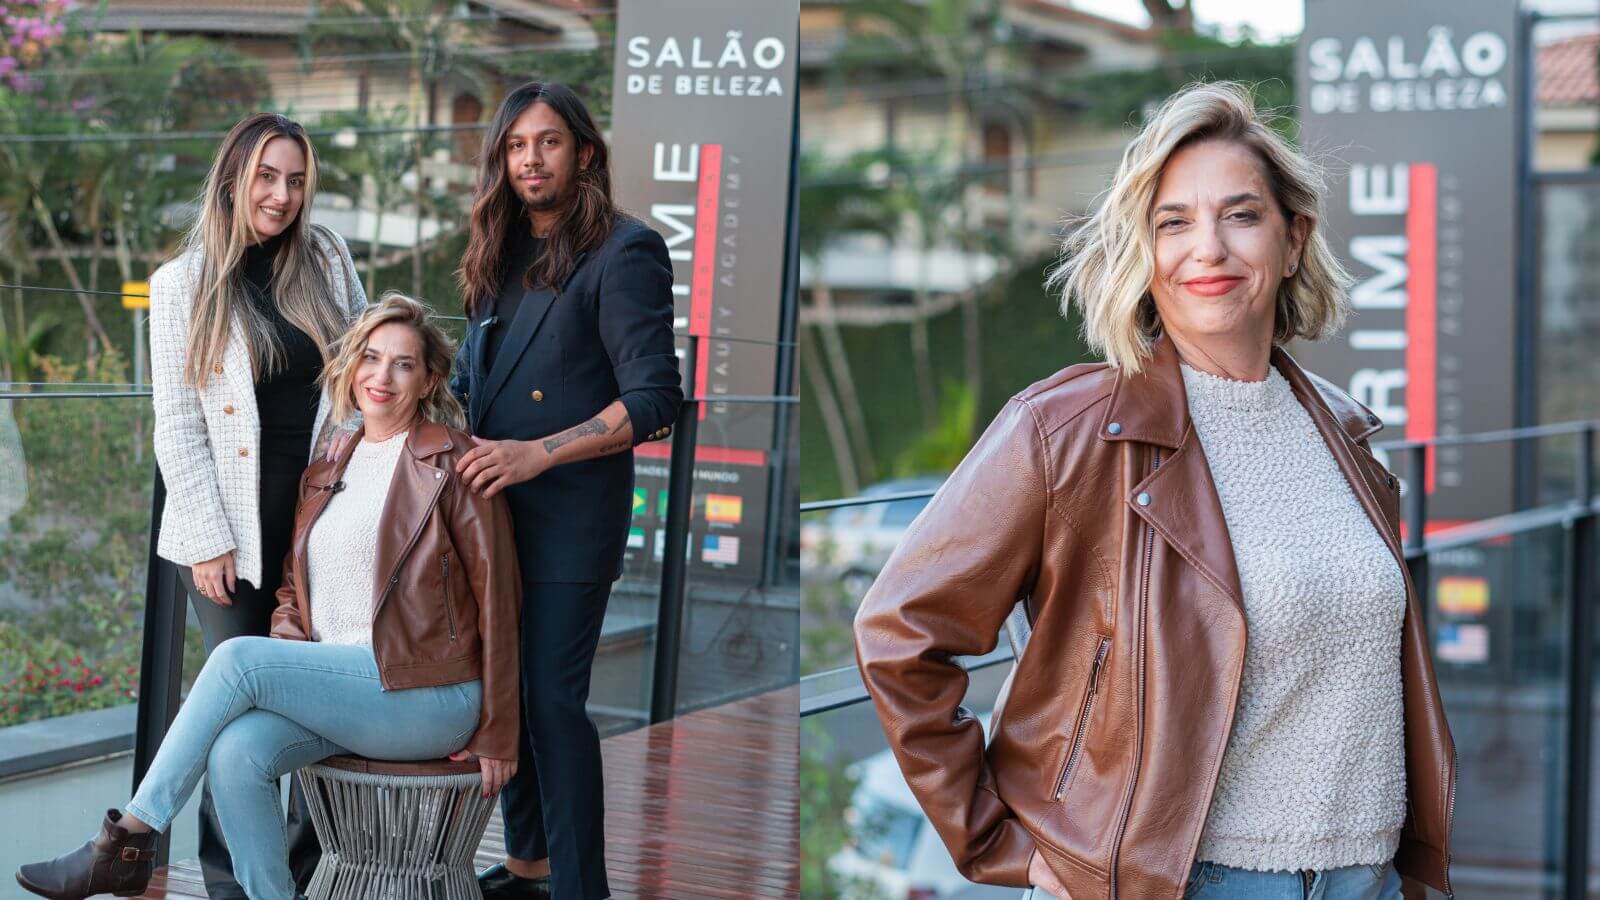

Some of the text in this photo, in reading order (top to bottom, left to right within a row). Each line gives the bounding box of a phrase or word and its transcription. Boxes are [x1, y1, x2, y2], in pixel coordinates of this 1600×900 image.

[627, 30, 786, 69] SALÃO
[1308, 25, 1507, 82] SALÃO
[626, 75, 784, 97] DE BELEZA
[651, 141, 699, 359] IME
[1348, 162, 1409, 498] RIME
